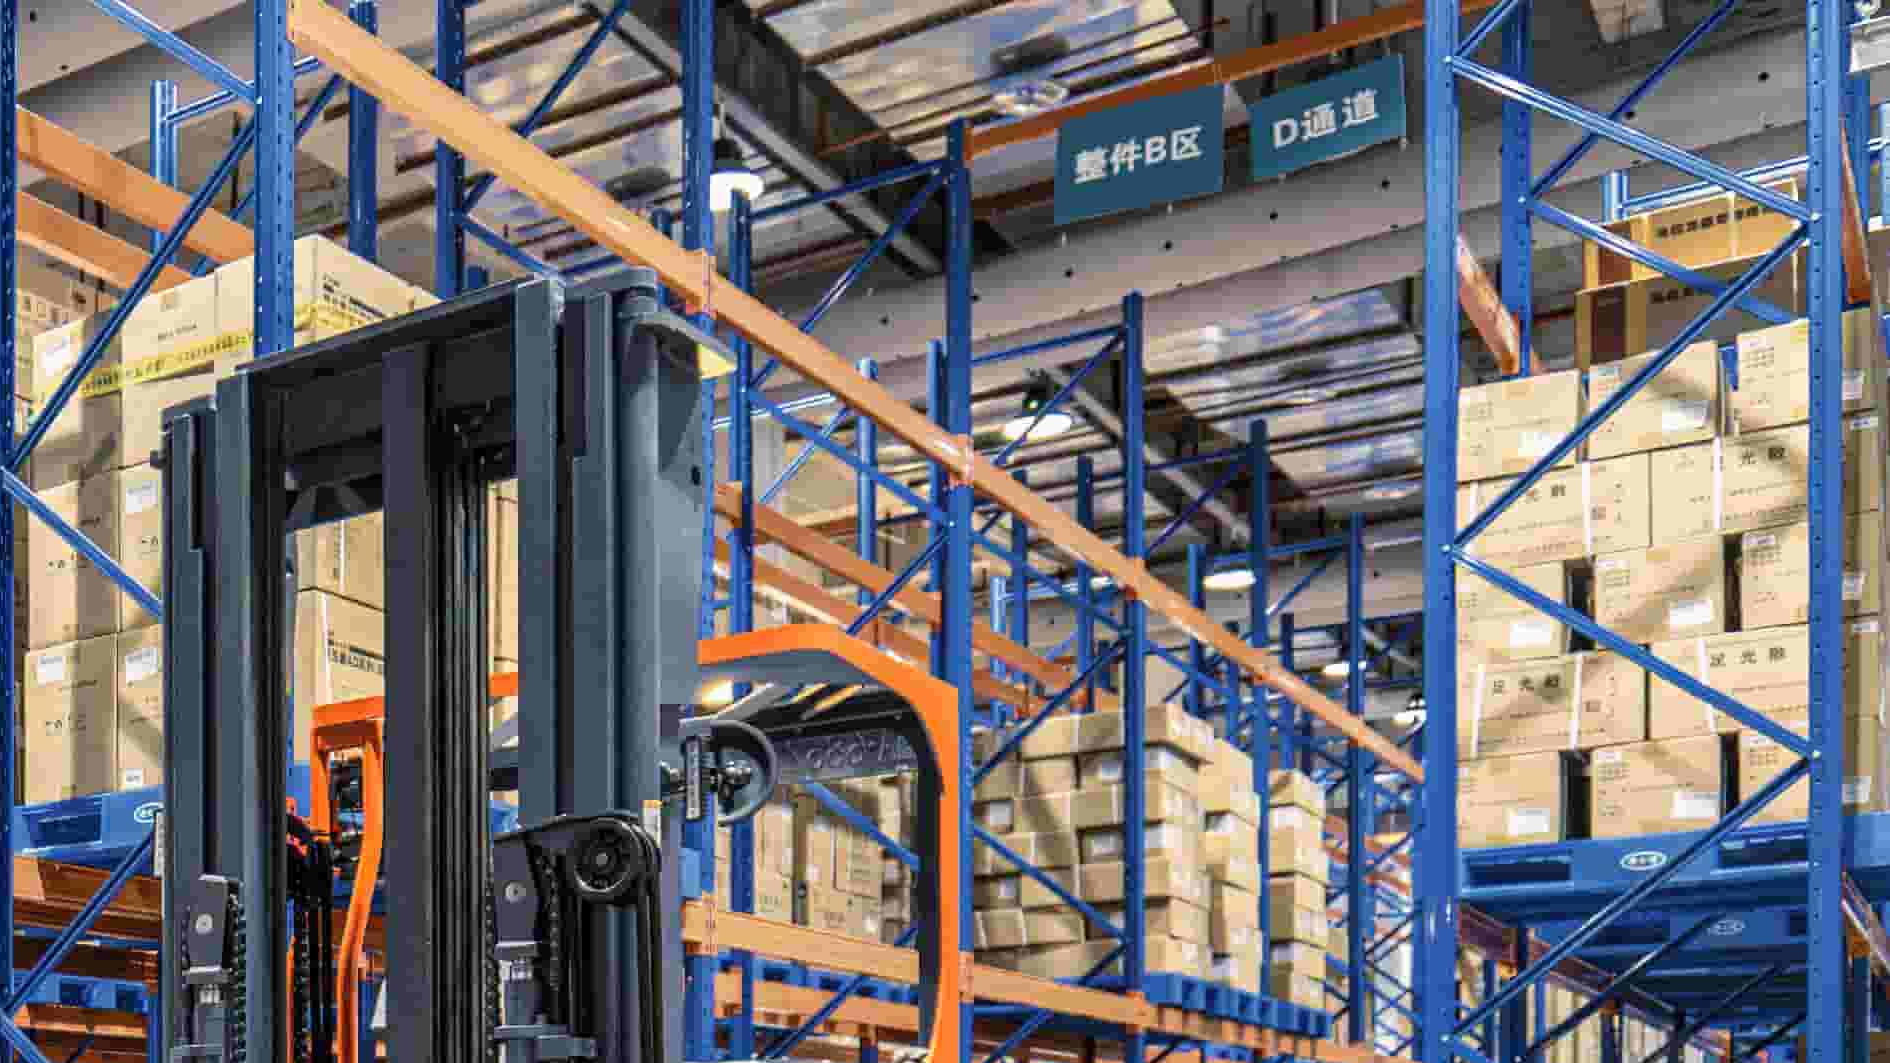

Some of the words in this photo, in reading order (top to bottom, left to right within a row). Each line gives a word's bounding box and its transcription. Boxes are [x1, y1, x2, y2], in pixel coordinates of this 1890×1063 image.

[1272, 88, 1380, 149] D通道
[1073, 124, 1204, 184] 整件B区
